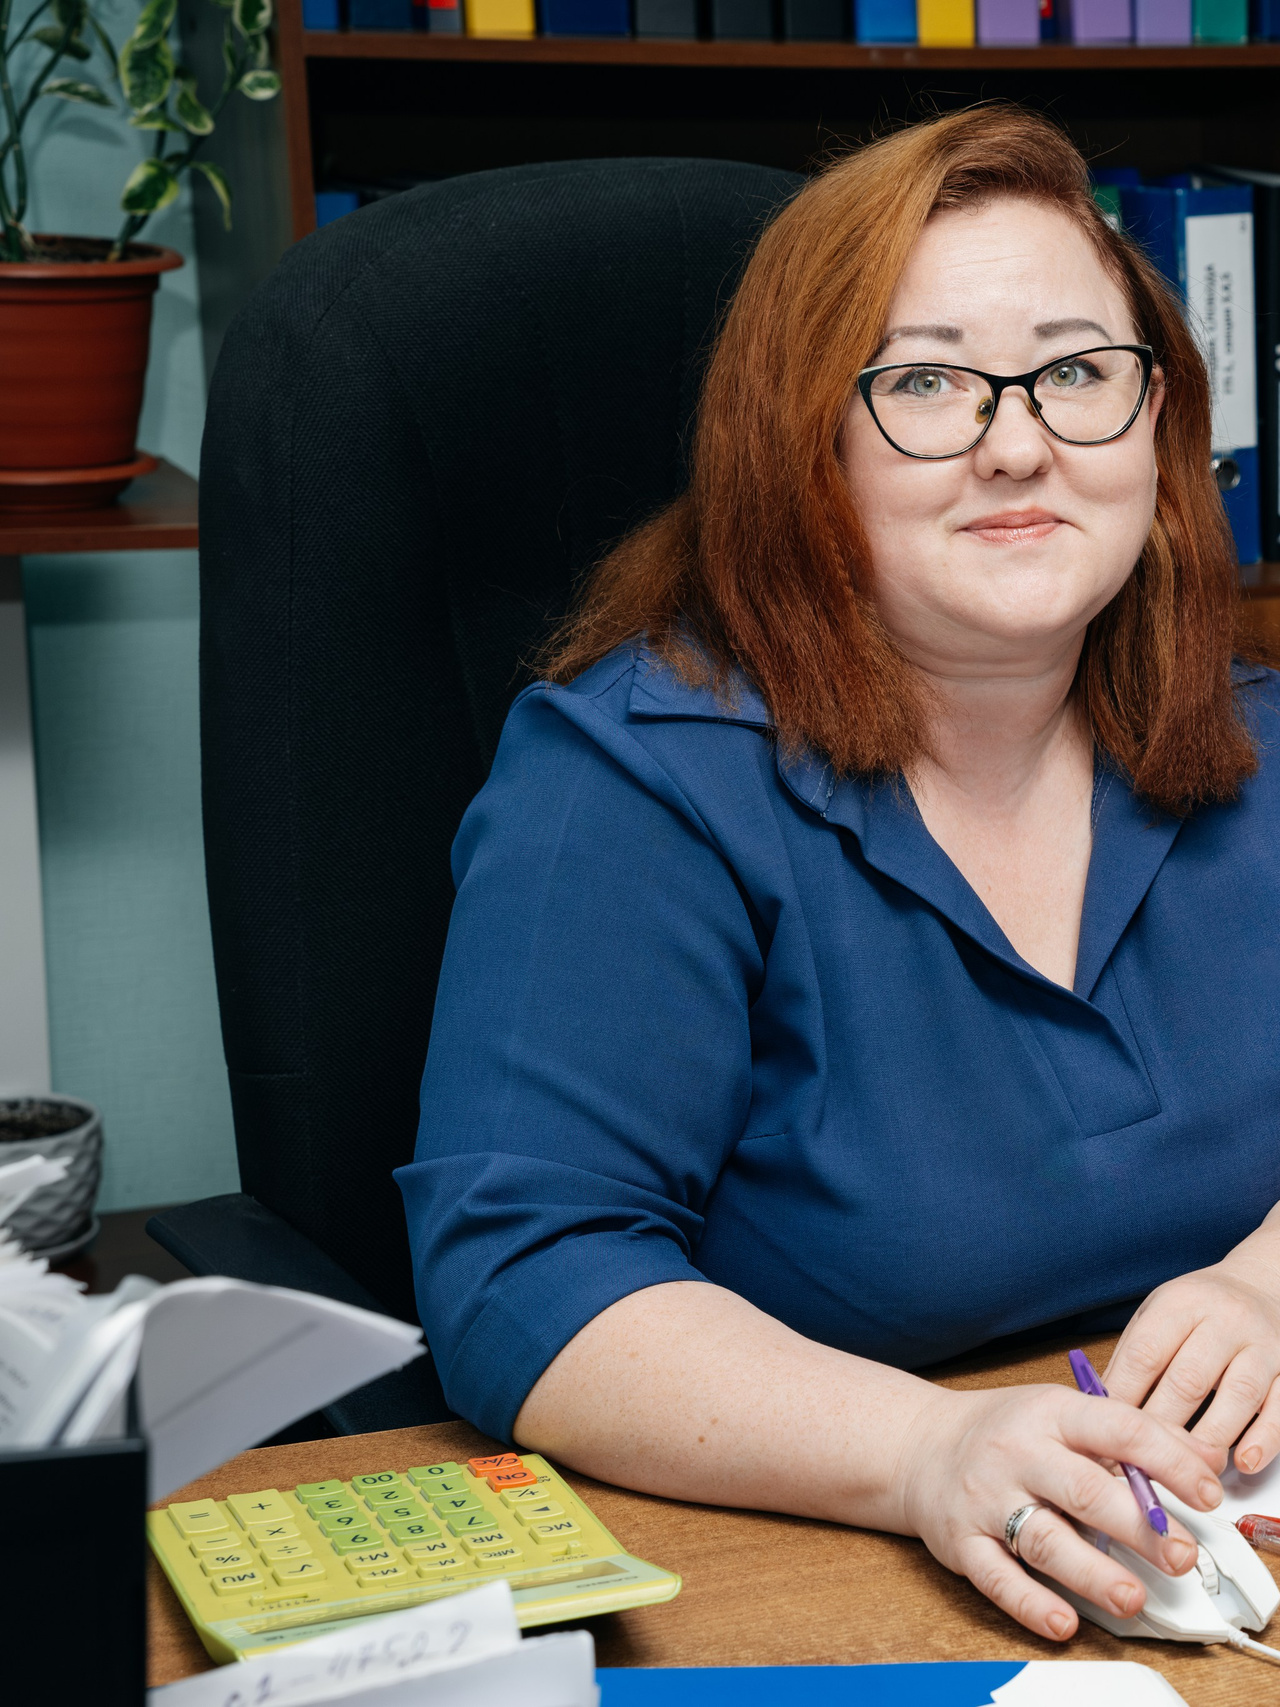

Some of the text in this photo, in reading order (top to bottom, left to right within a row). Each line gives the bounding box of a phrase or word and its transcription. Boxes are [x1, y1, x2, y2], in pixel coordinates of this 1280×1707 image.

[474, 1456, 518, 1467] C/AC
[428, 1466, 444, 1475] 0
[362, 1475, 393, 1485] 00
[497, 1471, 527, 1481] ON
[441, 1483, 454, 1491] 1
[381, 1491, 399, 1500] 2
[325, 1500, 341, 1508] 3
[451, 1499, 467, 1507] 4
[394, 1508, 411, 1516] 5
[337, 1517, 353, 1525] 6
[467, 1516, 483, 1525] 7
[407, 1525, 424, 1534] 8
[538, 1522, 572, 1533] MC
[351, 1534, 368, 1543] 9
[471, 1533, 503, 1544] MR
[354, 1551, 389, 1562] M+
[482, 1548, 515, 1559] MRC
[368, 1567, 398, 1577] M+
[222, 1572, 255, 1584] MU
